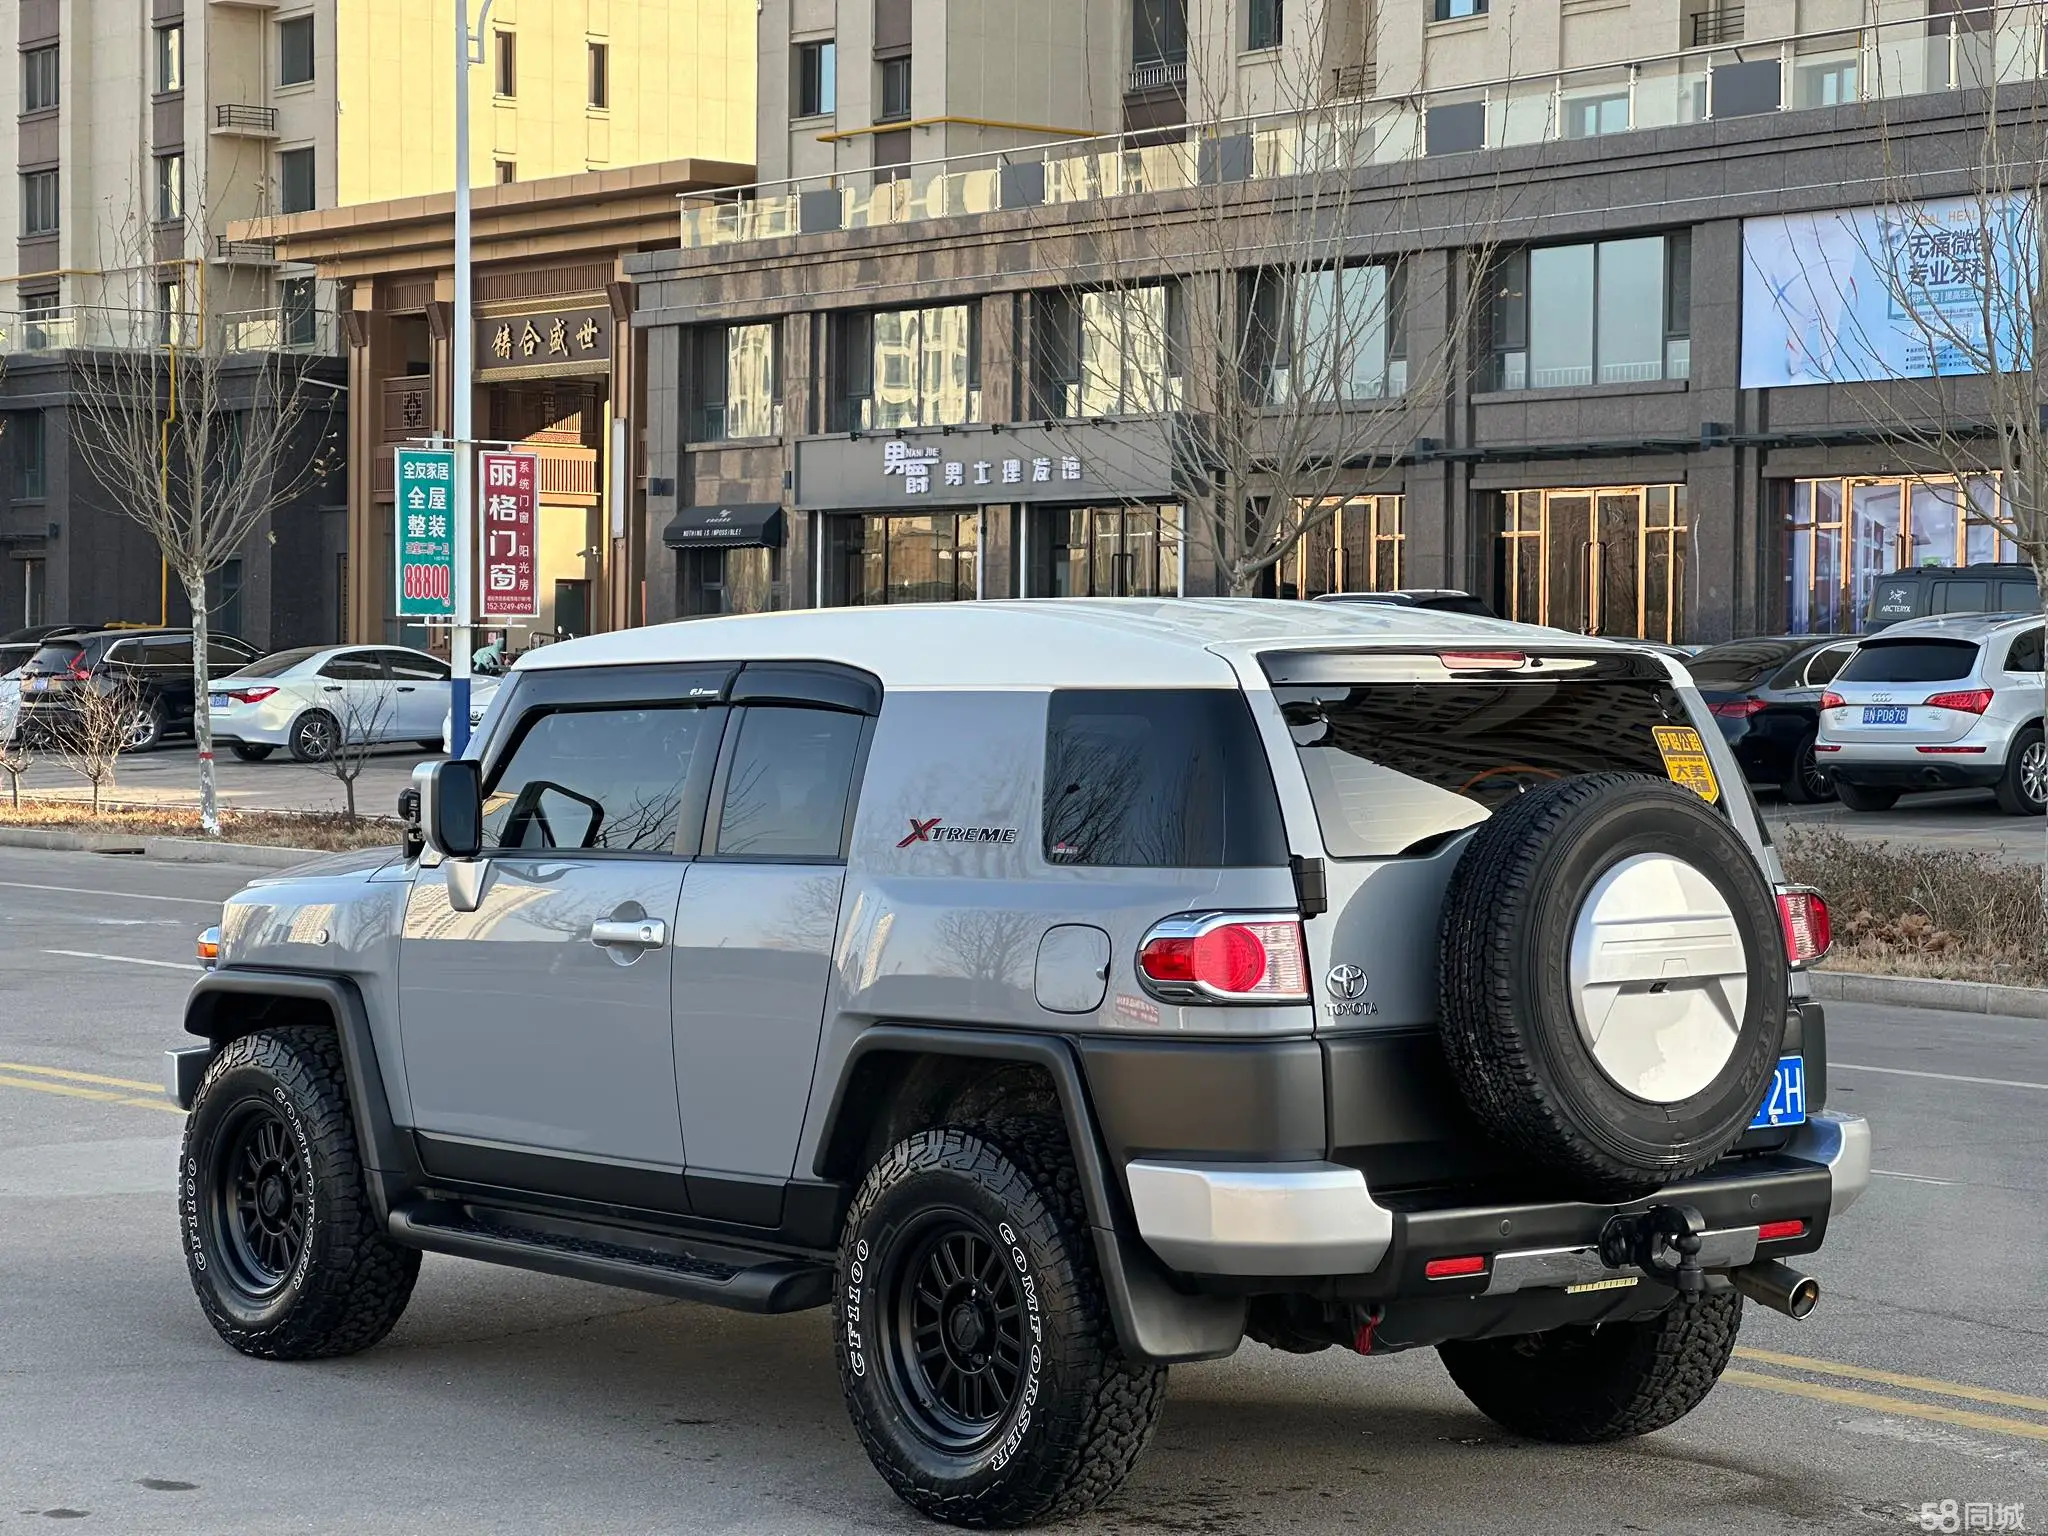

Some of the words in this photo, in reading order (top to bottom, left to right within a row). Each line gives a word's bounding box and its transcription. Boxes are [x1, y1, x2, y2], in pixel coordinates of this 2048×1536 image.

[404, 461, 449, 480] 全友家居
[408, 486, 447, 510] 全屋
[408, 514, 447, 538] 整装
[488, 459, 517, 590] 丽格门窗
[1673, 764, 1707, 778] 大美
[896, 818, 1017, 848] XTREME
[1325, 1002, 1379, 1017] TOYOTA
[1757, 1067, 1802, 1116] 2H
[187, 1157, 207, 1271] CF1100
[848, 1238, 870, 1377] CF1100
[992, 1221, 1042, 1472] COMFORSER
